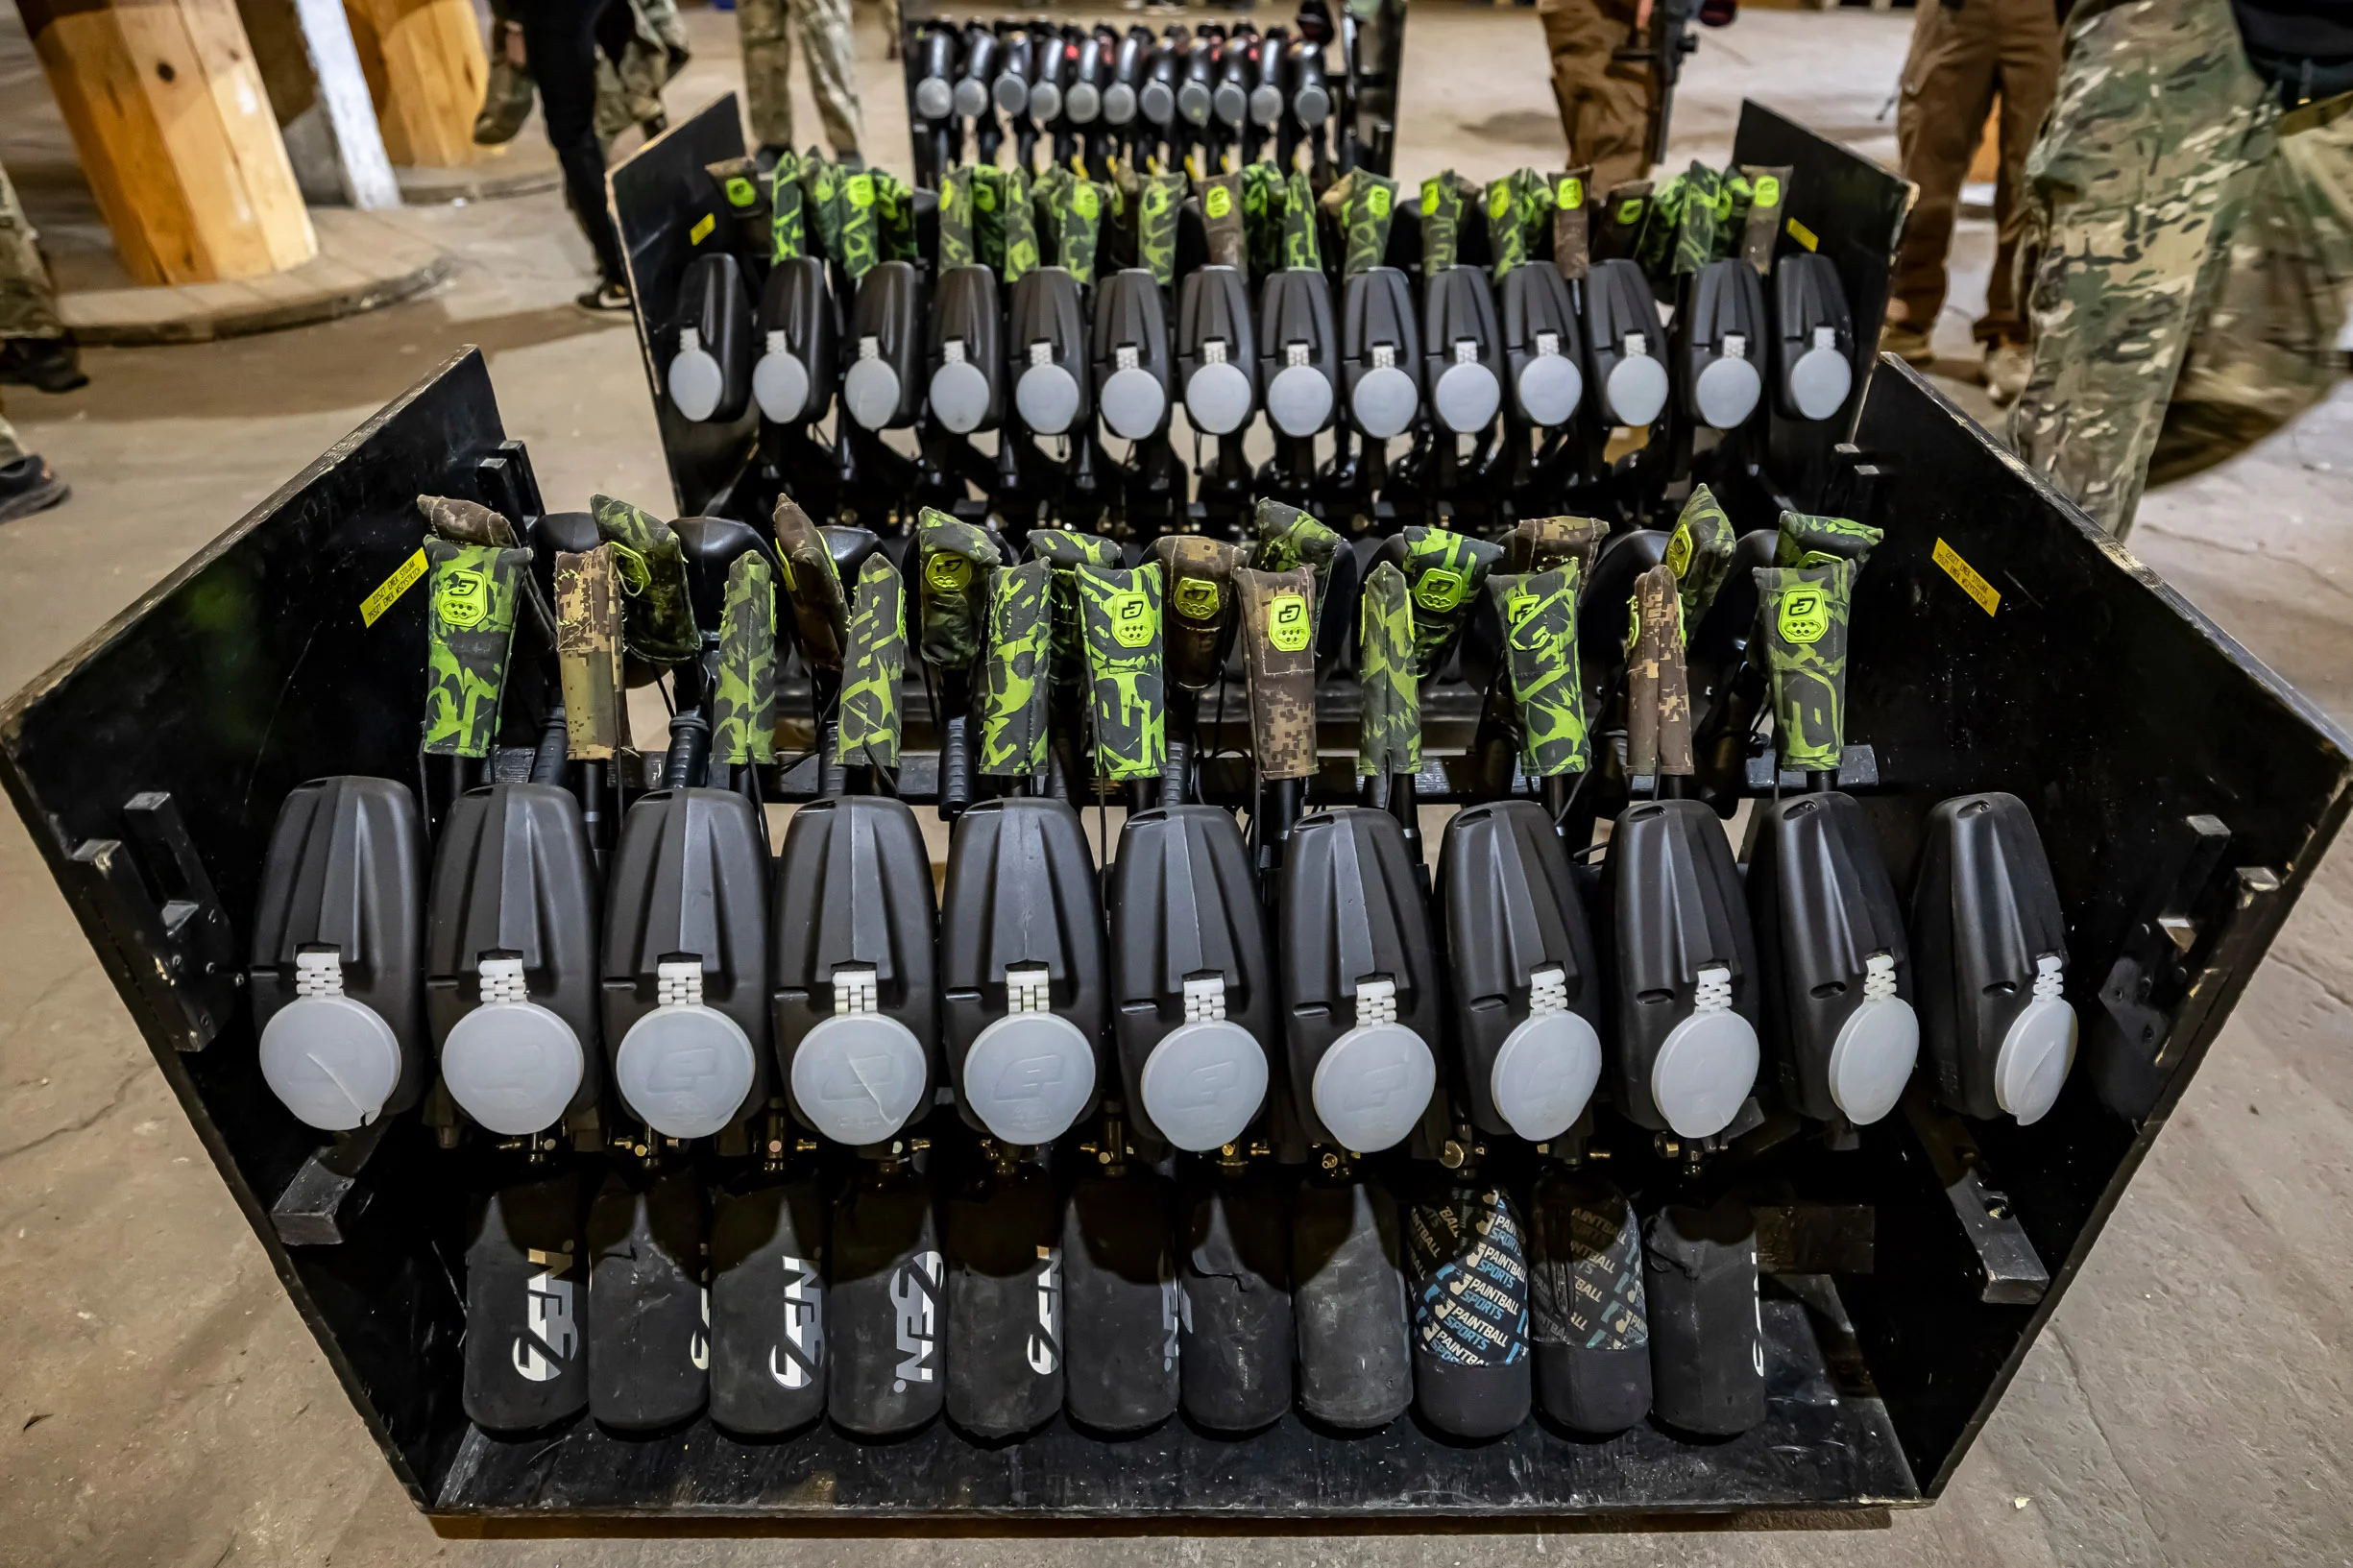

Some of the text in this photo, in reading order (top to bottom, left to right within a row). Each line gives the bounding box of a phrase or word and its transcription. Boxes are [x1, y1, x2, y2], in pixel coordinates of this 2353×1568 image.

[1477, 1260, 1516, 1290] SPORTS
[1484, 1246, 1526, 1284] PAINTBALL
[1461, 1290, 1505, 1321] SPORTS
[1469, 1278, 1519, 1315] PAINTBALL
[1444, 1315, 1491, 1351] SPORTS
[1451, 1306, 1510, 1348] PAINTBALL
